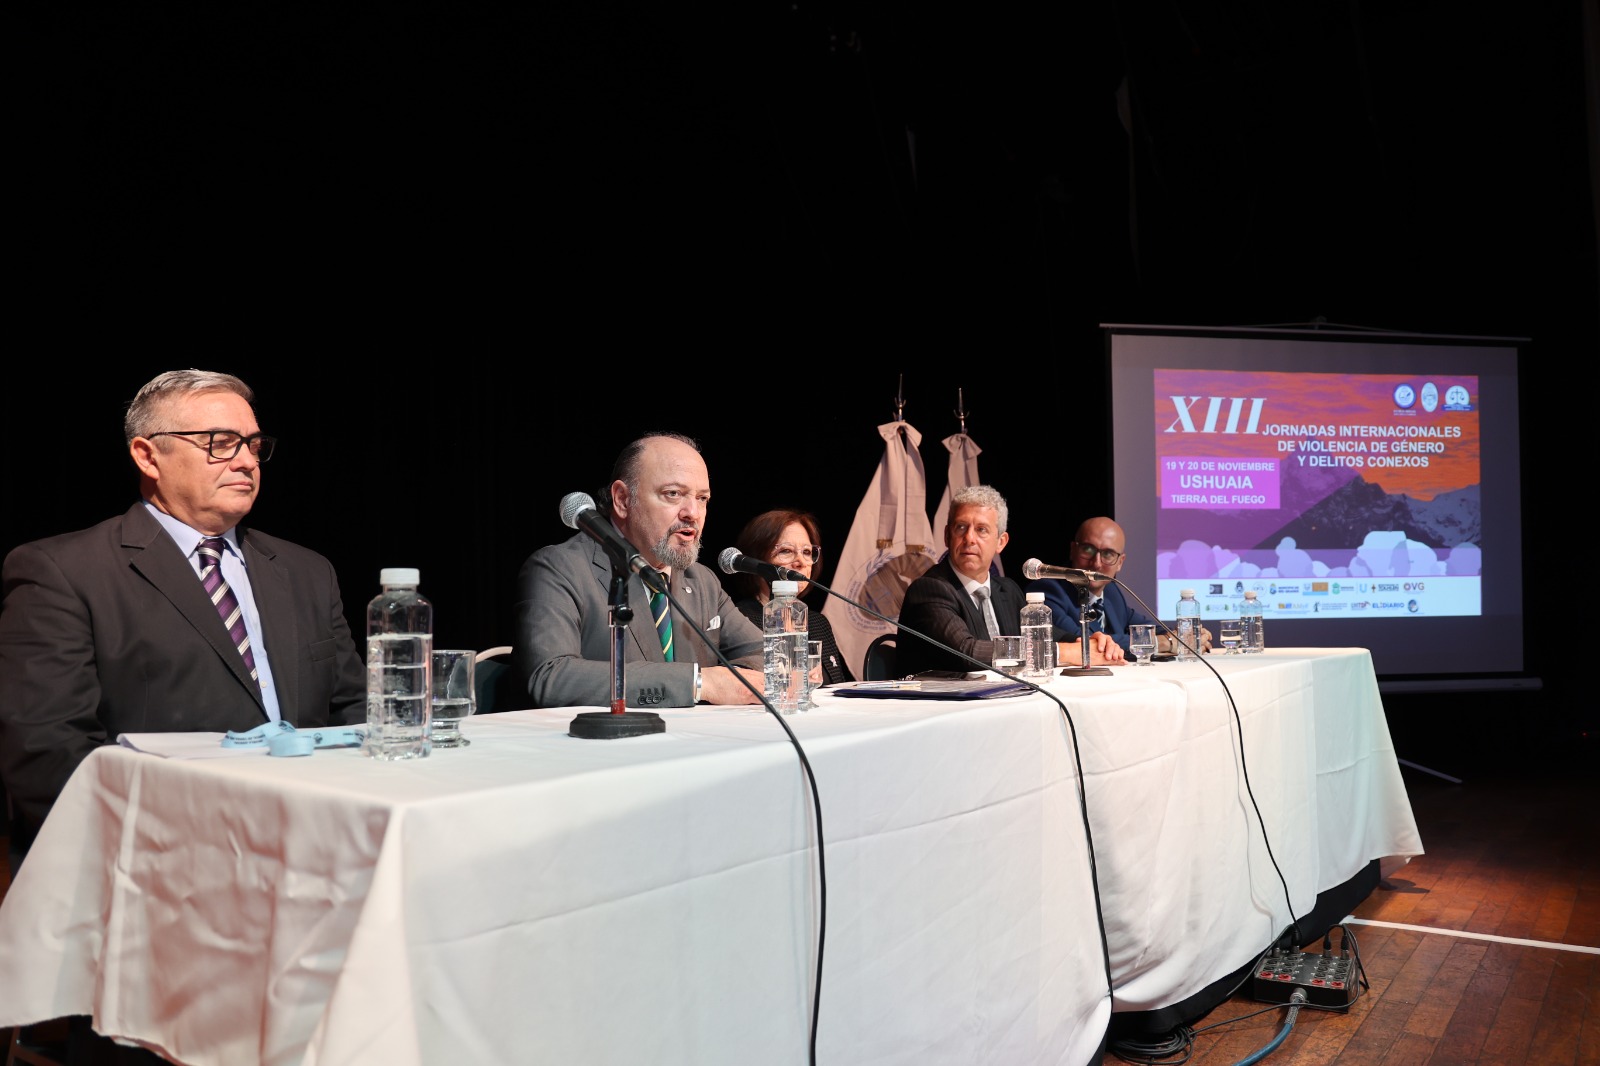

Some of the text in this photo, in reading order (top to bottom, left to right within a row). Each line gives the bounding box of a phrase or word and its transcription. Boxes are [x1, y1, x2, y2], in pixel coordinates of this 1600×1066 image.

[1164, 396, 1462, 438] XIII JORNADAS INTERNACIONALES
[1277, 439, 1445, 453] DE VIOLENCIA DE GÉNERO
[1166, 461, 1275, 471] 19 Y 20 DE NOVIEMBRE
[1297, 455, 1429, 468] Y DELITOS CONEXOS
[1180, 474, 1254, 490] USHUAIA
[1171, 494, 1266, 505] TIERRA DEL FUEGO
